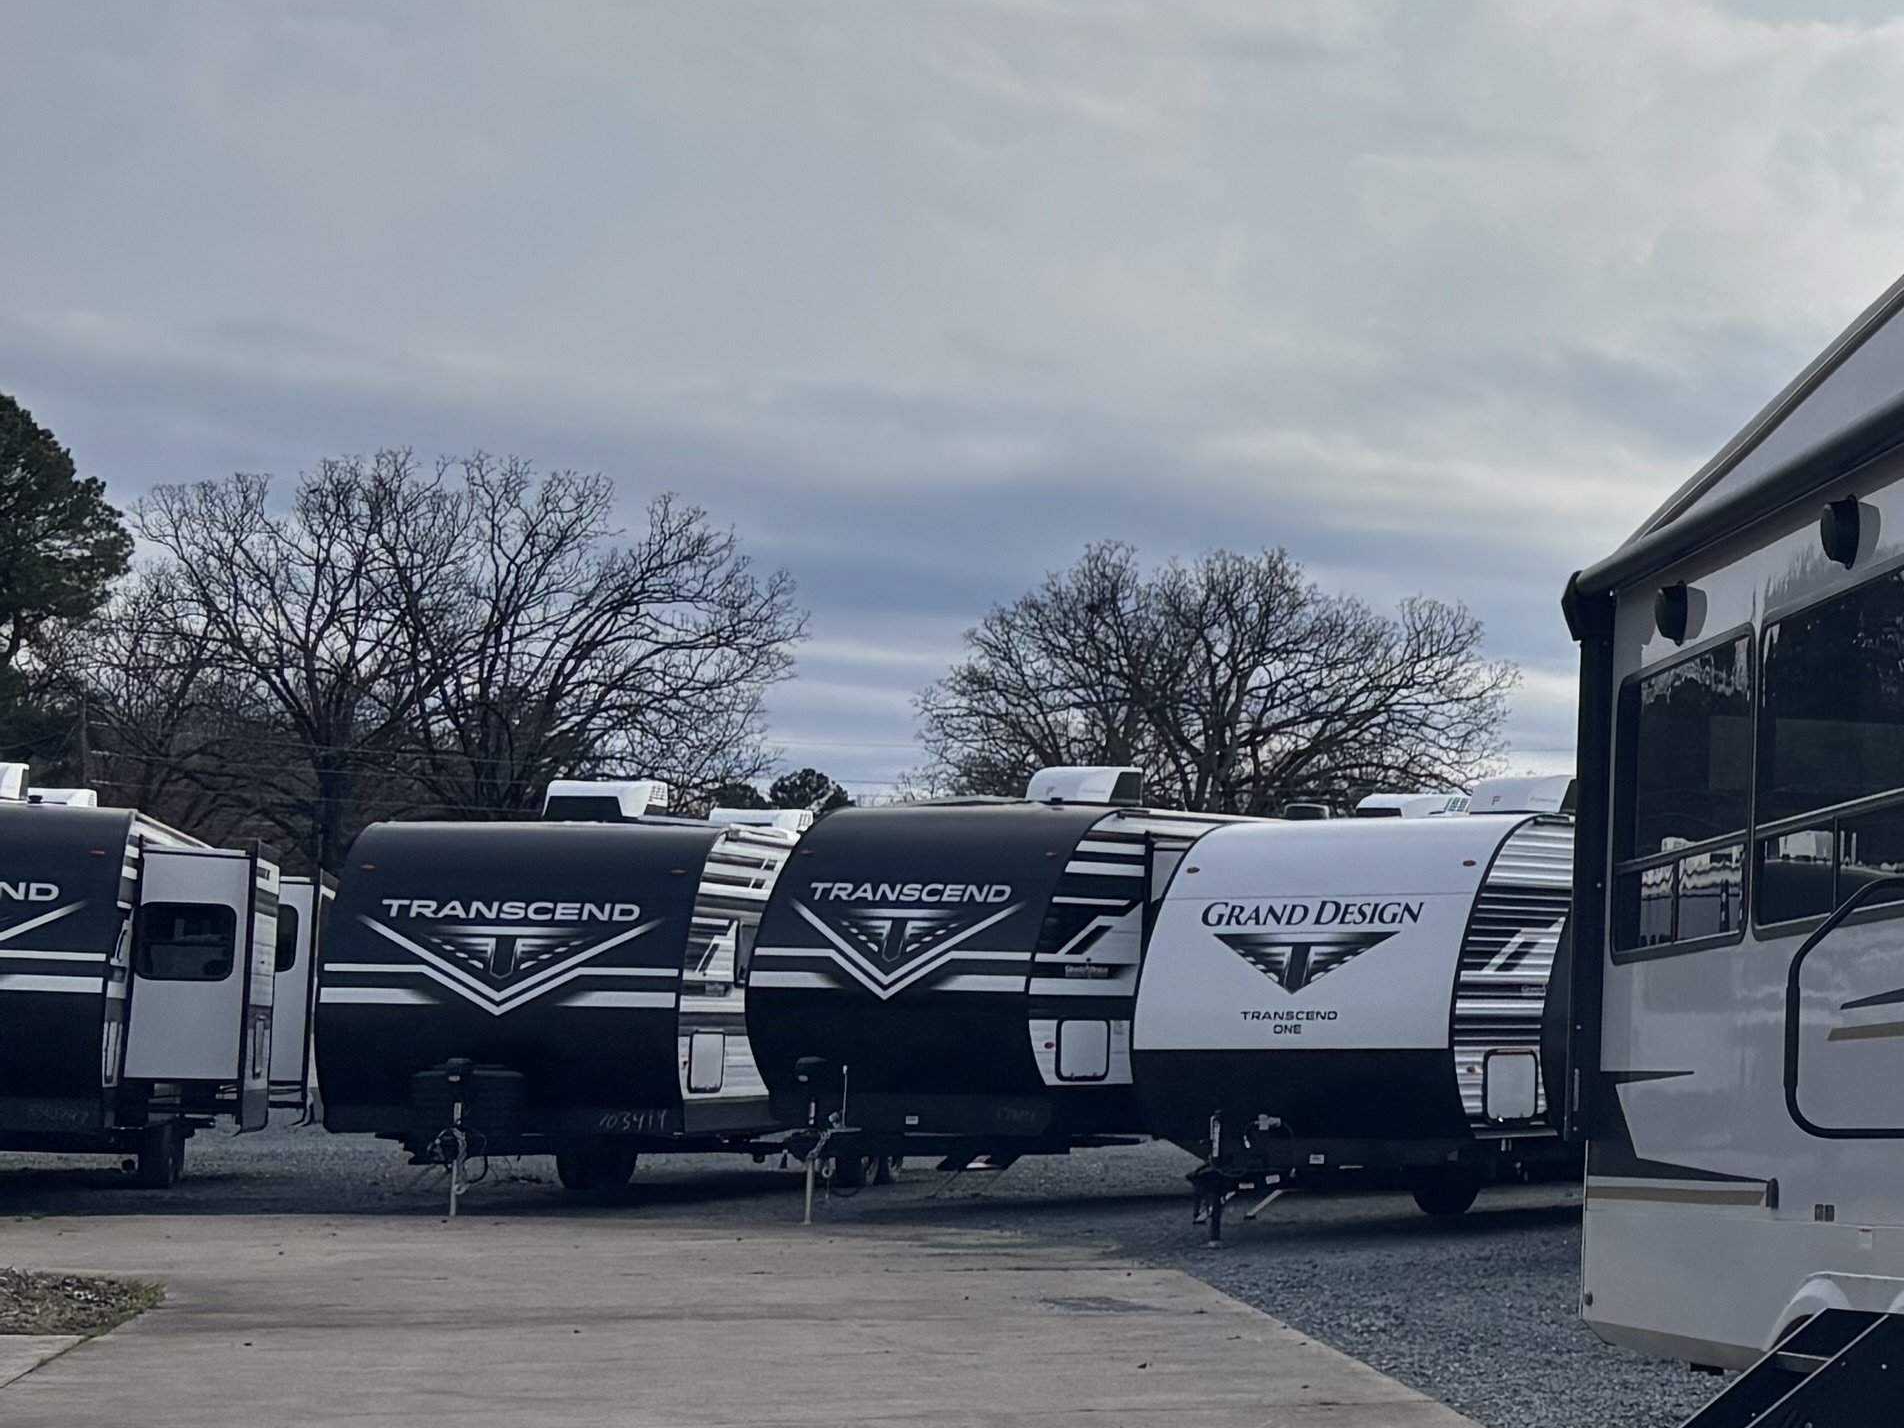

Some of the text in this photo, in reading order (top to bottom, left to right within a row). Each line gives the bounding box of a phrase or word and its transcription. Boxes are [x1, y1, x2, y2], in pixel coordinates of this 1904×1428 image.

[810, 882, 1012, 903] TRANSCEND
[382, 899, 640, 921] TRANSCEND
[1201, 900, 1424, 927] GRAND DESIGN
[1240, 1010, 1338, 1021] TRANSCEND
[1273, 1024, 1302, 1035] ONE
